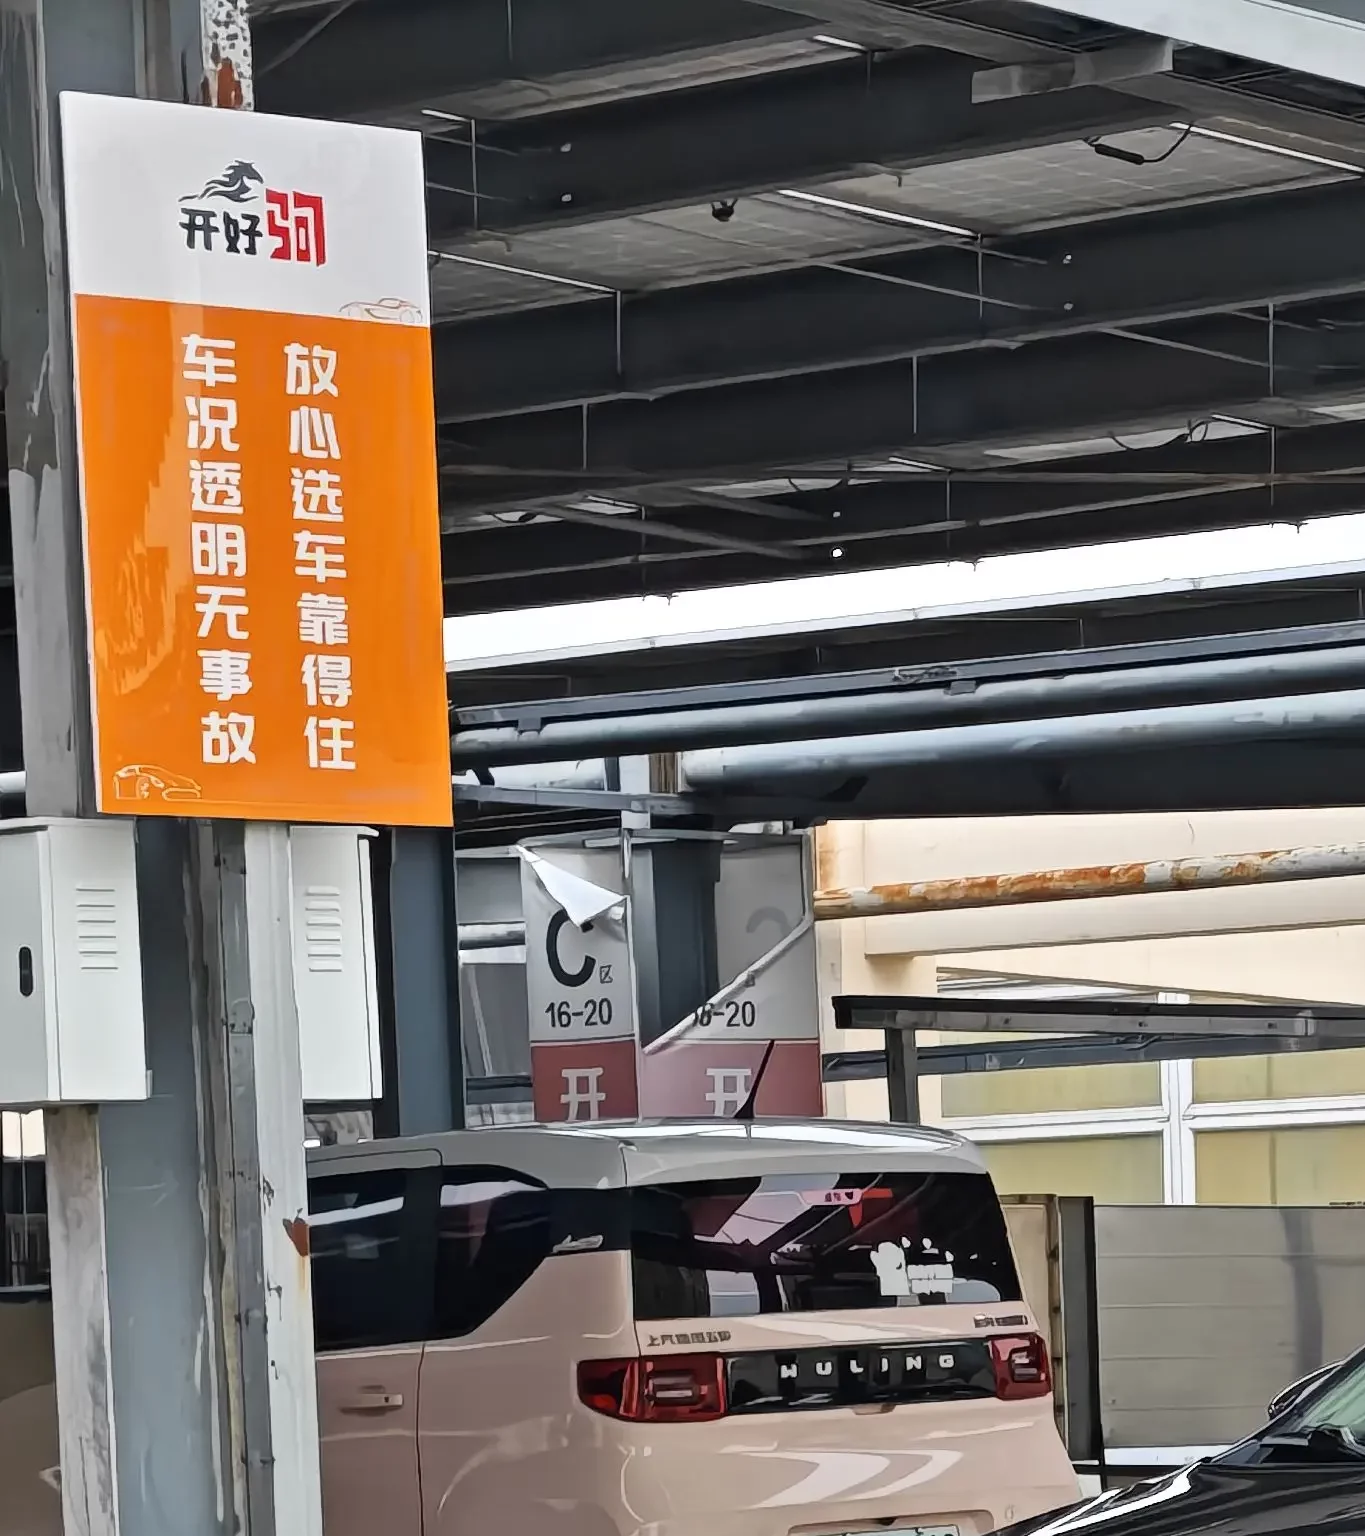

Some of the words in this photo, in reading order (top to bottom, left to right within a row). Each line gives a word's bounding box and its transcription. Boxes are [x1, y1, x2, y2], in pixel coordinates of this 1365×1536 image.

[181, 333, 257, 765] 车况透明无事故
[284, 343, 357, 770] 放心选车靠得住
[545, 997, 613, 1028] 16-20
[780, 1353, 955, 1380] WULING
